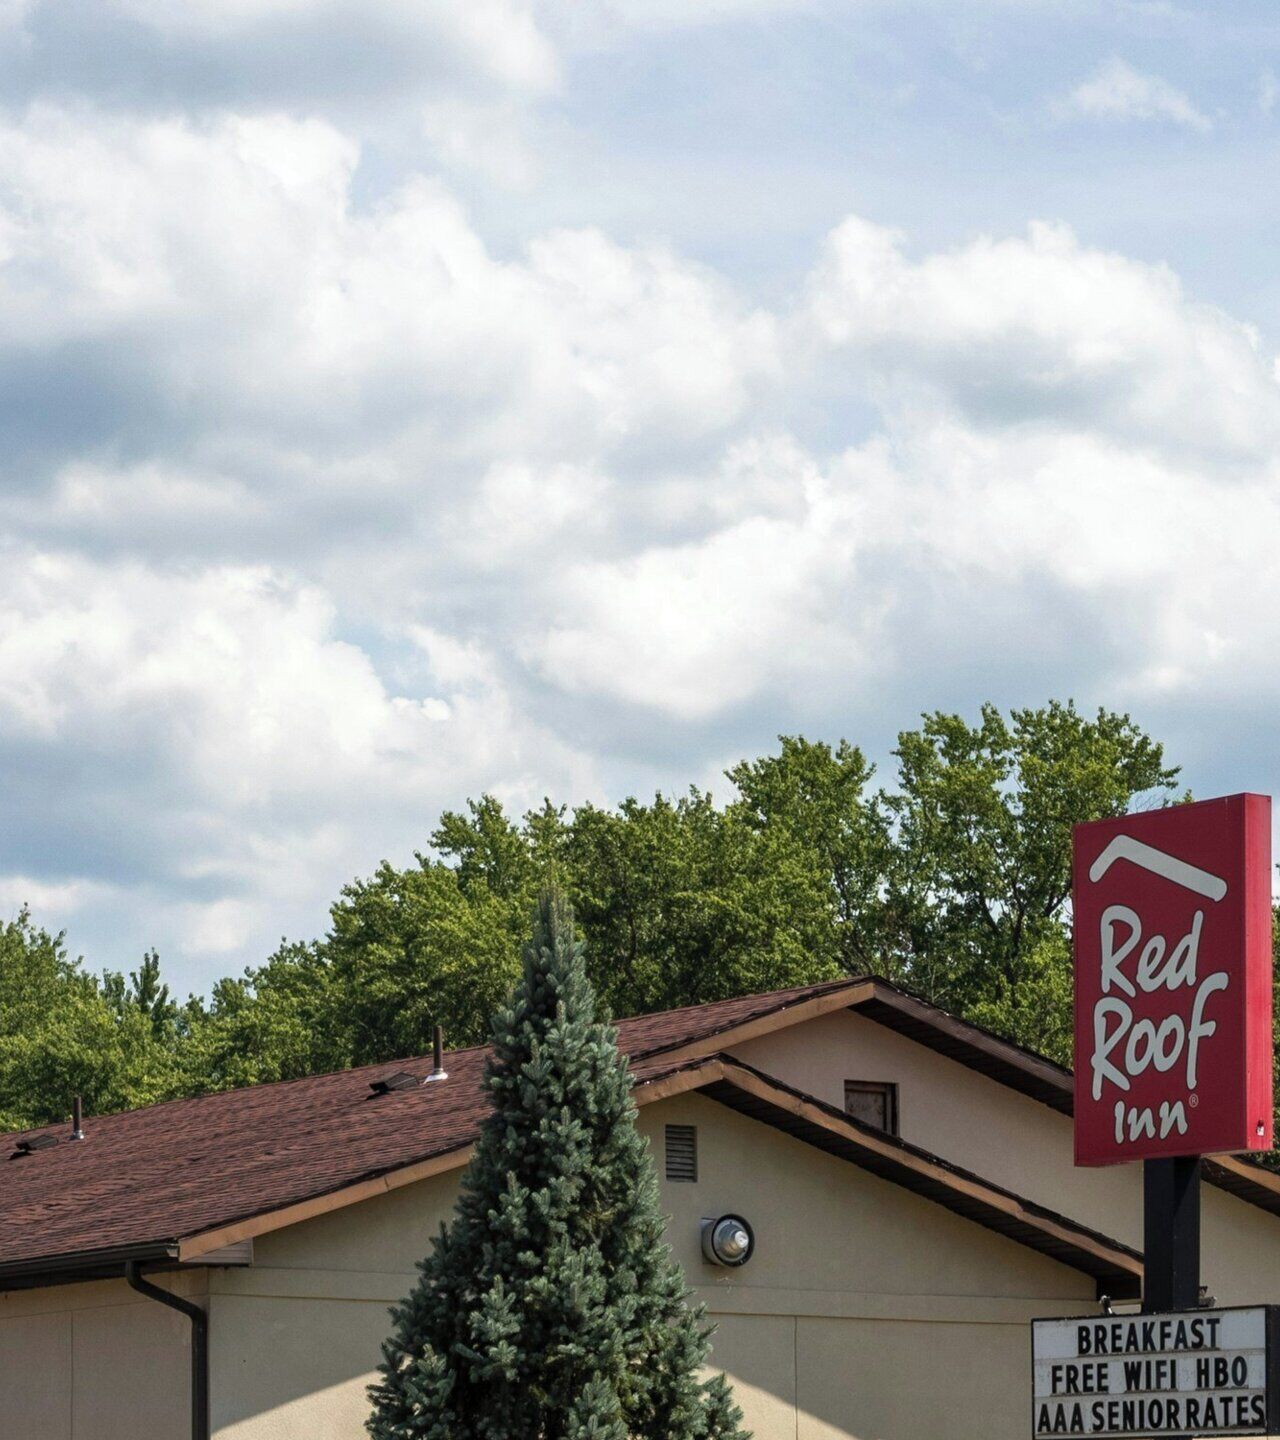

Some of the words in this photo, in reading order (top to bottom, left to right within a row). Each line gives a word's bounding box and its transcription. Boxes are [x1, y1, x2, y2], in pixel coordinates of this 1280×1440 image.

[1101, 904, 1204, 998] Red
[1090, 972, 1230, 1101] Roof
[1077, 1318, 1221, 1354] BREAKFAST
[1051, 1362, 1109, 1394] FREE
[1123, 1359, 1177, 1391] WIFI
[1196, 1355, 1248, 1388] HBO
[1037, 1402, 1085, 1433] AAA
[1091, 1398, 1181, 1431] SENIOR
[1185, 1394, 1266, 1428] RATES
